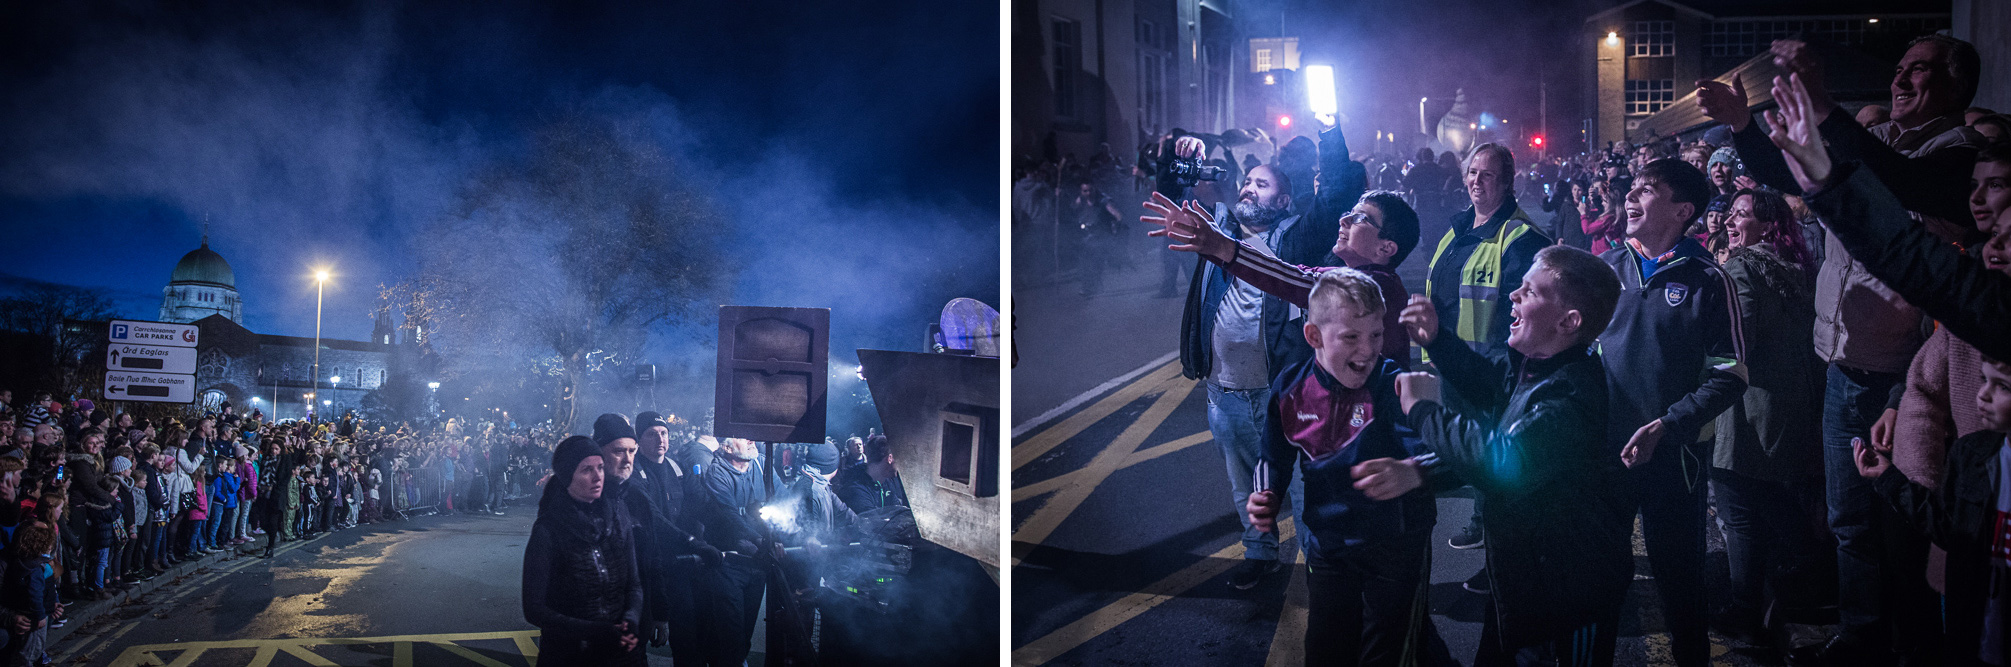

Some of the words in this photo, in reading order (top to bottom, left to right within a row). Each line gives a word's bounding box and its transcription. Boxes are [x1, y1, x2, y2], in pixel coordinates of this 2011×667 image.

[1476, 270, 1494, 284] 21
[115, 325, 127, 338] P
[140, 348, 169, 356] Eaglais
